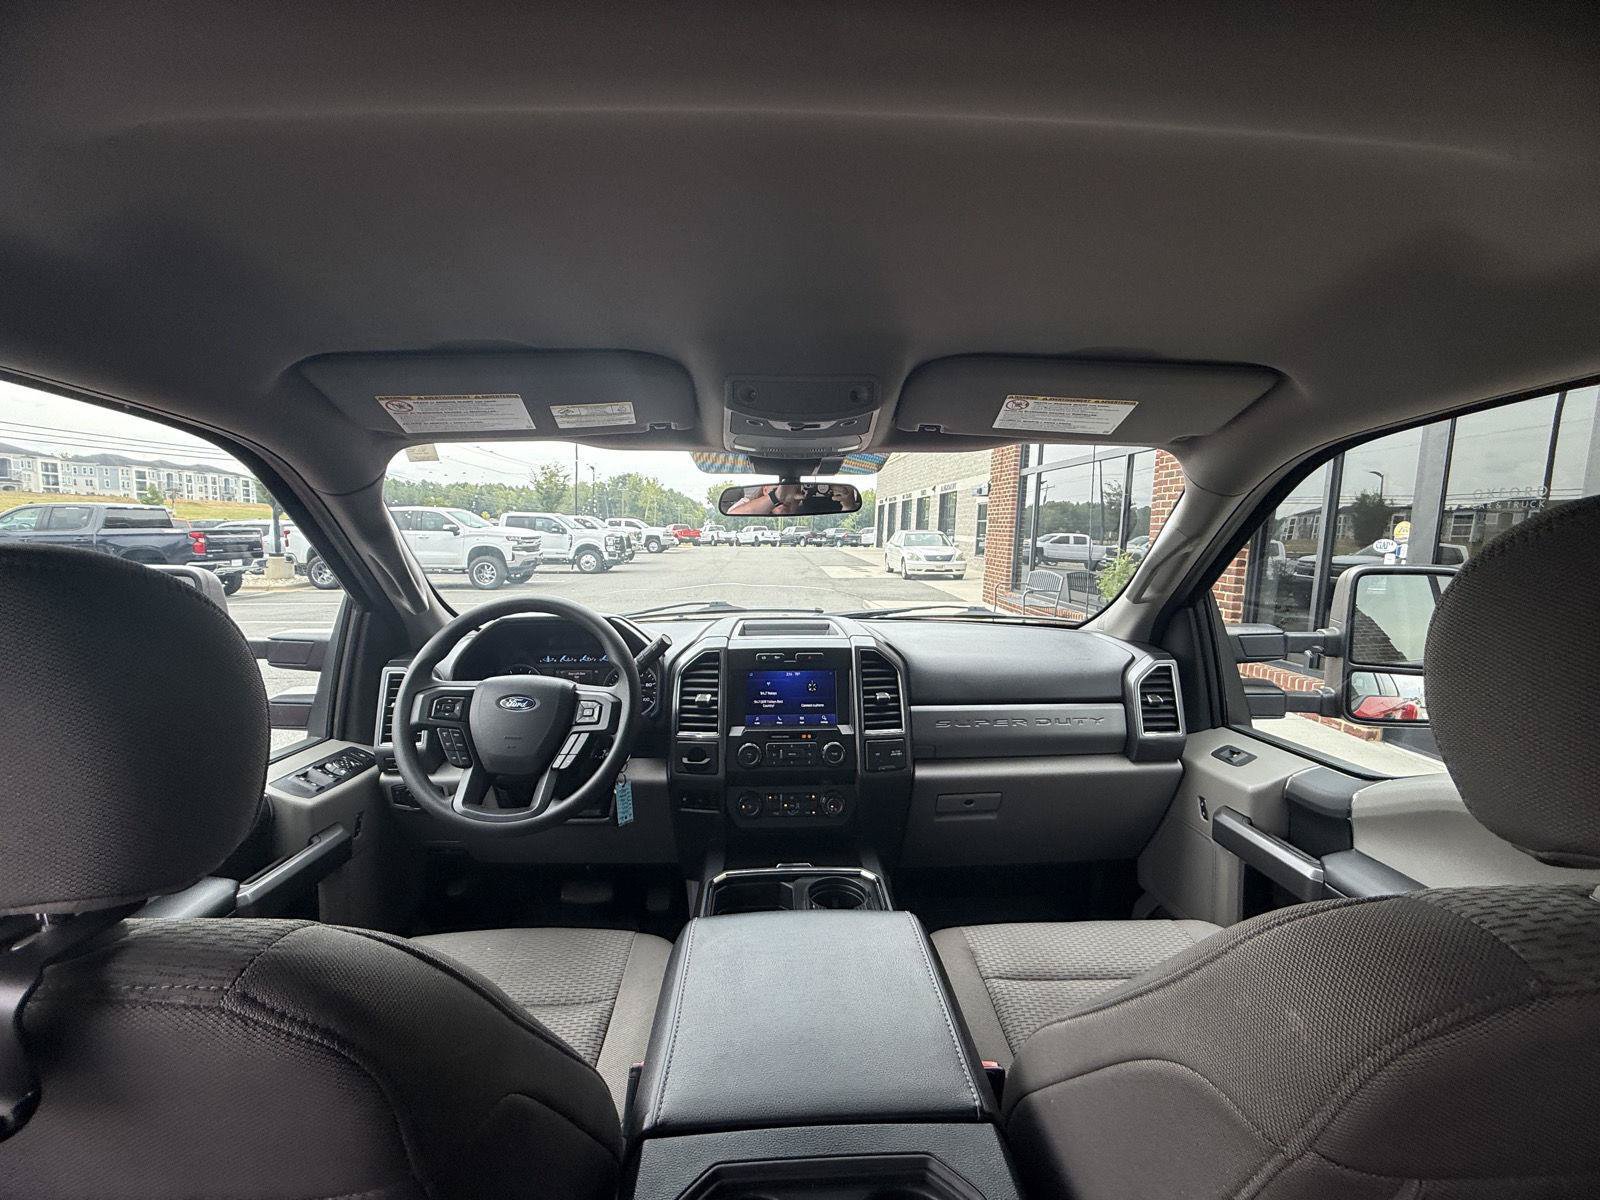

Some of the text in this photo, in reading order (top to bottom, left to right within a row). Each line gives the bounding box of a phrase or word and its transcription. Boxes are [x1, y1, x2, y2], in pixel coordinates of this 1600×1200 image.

[1473, 486, 1548, 499] OXFORD
[1507, 500, 1546, 508] TRUCK
[935, 717, 1105, 728] SUPER DUTY
